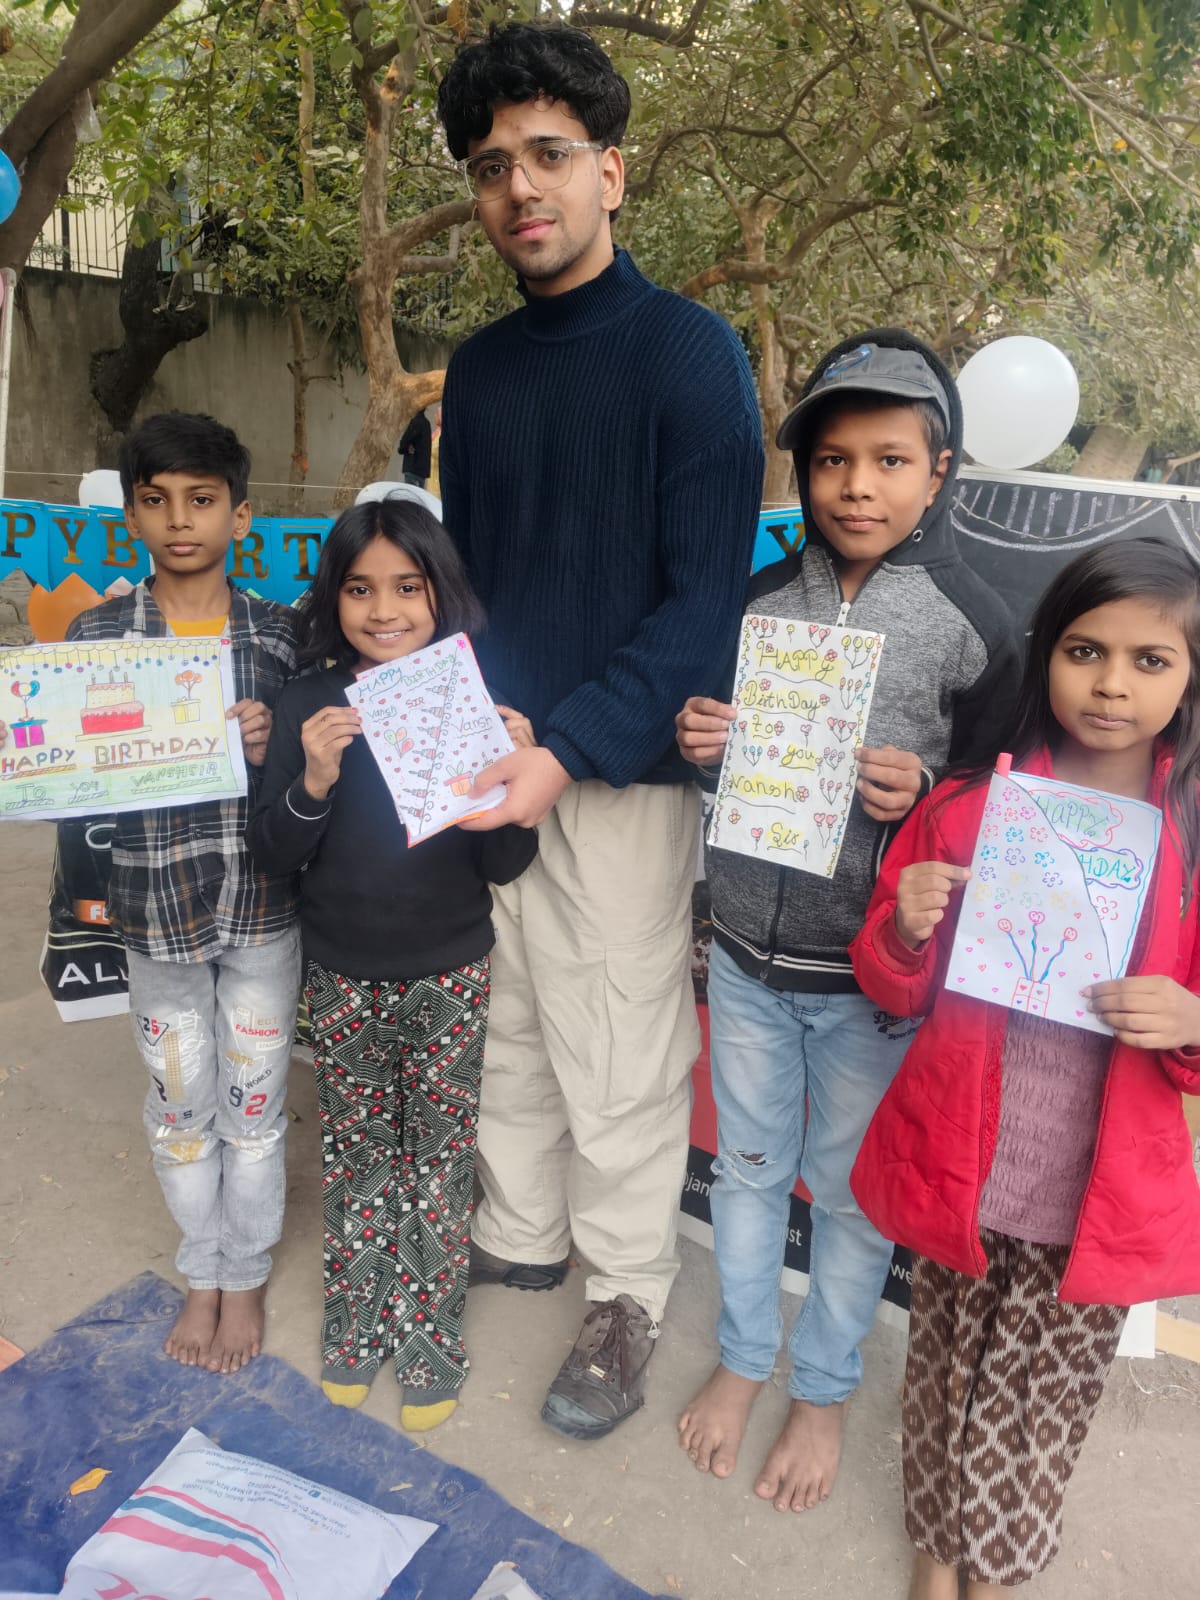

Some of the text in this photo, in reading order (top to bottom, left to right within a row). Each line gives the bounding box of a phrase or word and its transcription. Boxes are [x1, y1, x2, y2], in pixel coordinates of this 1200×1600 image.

[451, 715, 493, 732] Vansh
[2, 737, 219, 773] HAPPY BIRTHDAY
[781, 744, 815, 765] you
[58, 962, 129, 988] AL
[235, 1024, 279, 1037] FASHION
[245, 1069, 272, 1089] WORLD
[683, 1172, 710, 1198] jan
[786, 1227, 803, 1247] st
